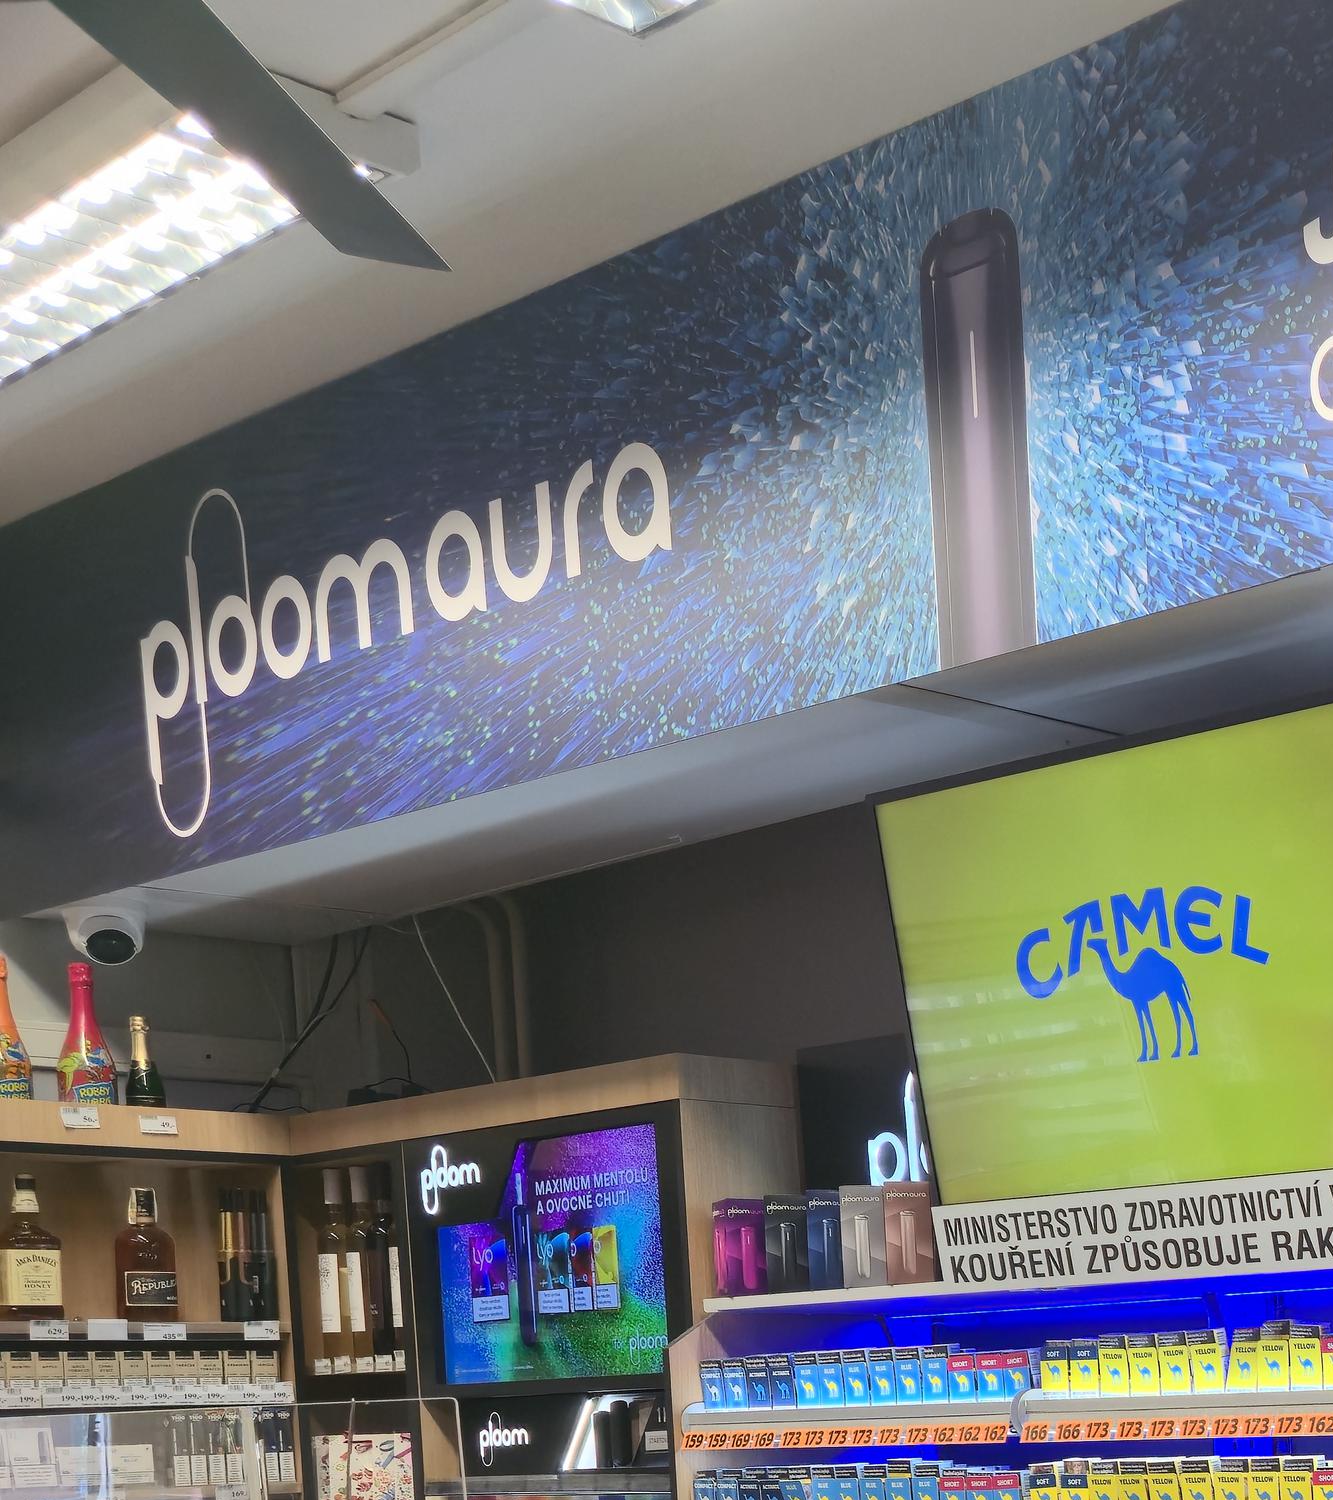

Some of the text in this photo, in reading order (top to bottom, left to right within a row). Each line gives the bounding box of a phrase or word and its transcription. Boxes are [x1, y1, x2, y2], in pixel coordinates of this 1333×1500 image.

[1016, 884, 1271, 1000] CAMEL
[535, 1173, 591, 1196] MAXIMUM
[536, 1200, 544, 1215] A
[546, 1193, 592, 1214] OVOCNÉ
[943, 1203, 1117, 1247] MINISTERSTVO
[1127, 1179, 1323, 1232] ZDRAVOTNICTVÍ
[950, 1244, 1074, 1284] KOUŘENÍ
[1087, 1234, 1259, 1274] ZPŮSOBUJE
